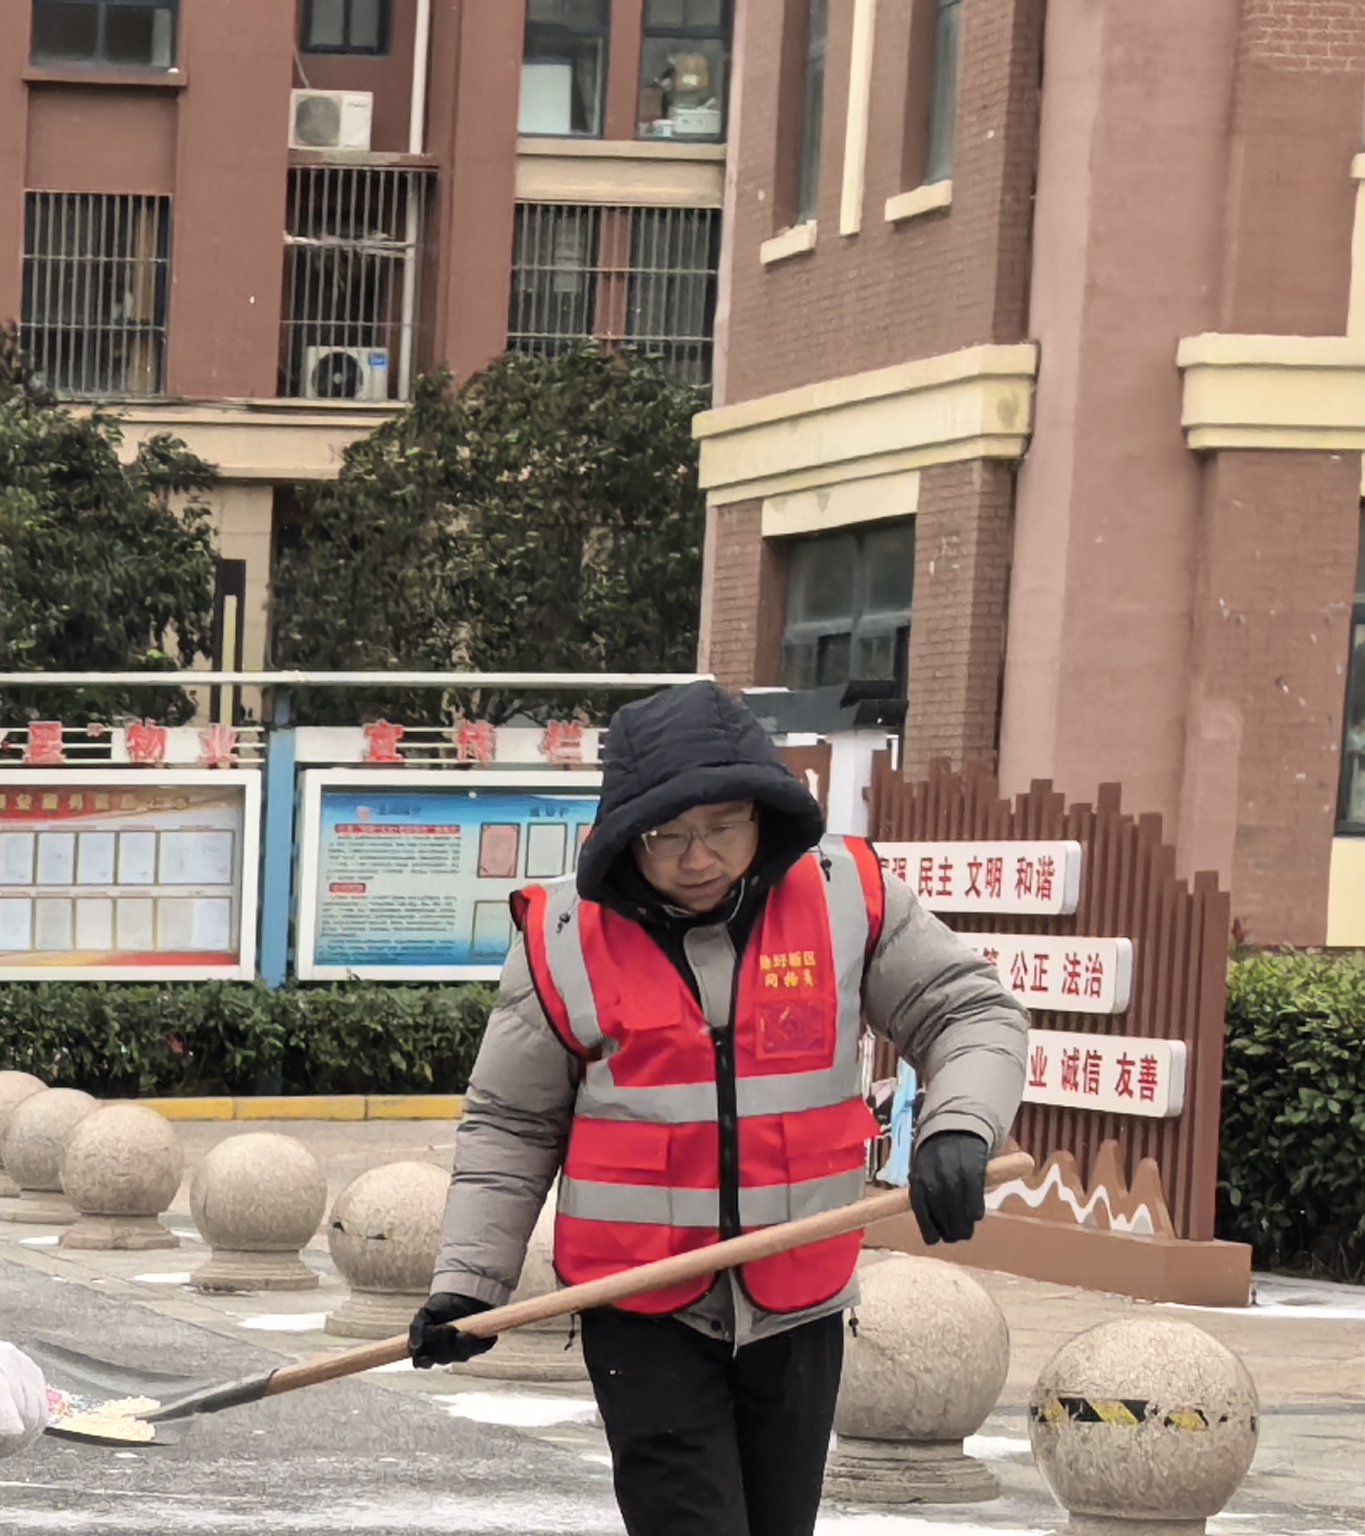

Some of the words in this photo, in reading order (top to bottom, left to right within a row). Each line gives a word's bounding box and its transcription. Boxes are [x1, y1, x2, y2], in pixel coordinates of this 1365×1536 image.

[362, 719, 582, 763] 宣传栏
[919, 856, 953, 898] 民主
[965, 855, 1003, 898] 文明
[1016, 855, 1055, 901] 和谐
[1011, 951, 1049, 993] 公正
[1062, 952, 1103, 998] 法治
[1061, 1047, 1103, 1095] 诚信
[1115, 1052, 1158, 1102] 友善
